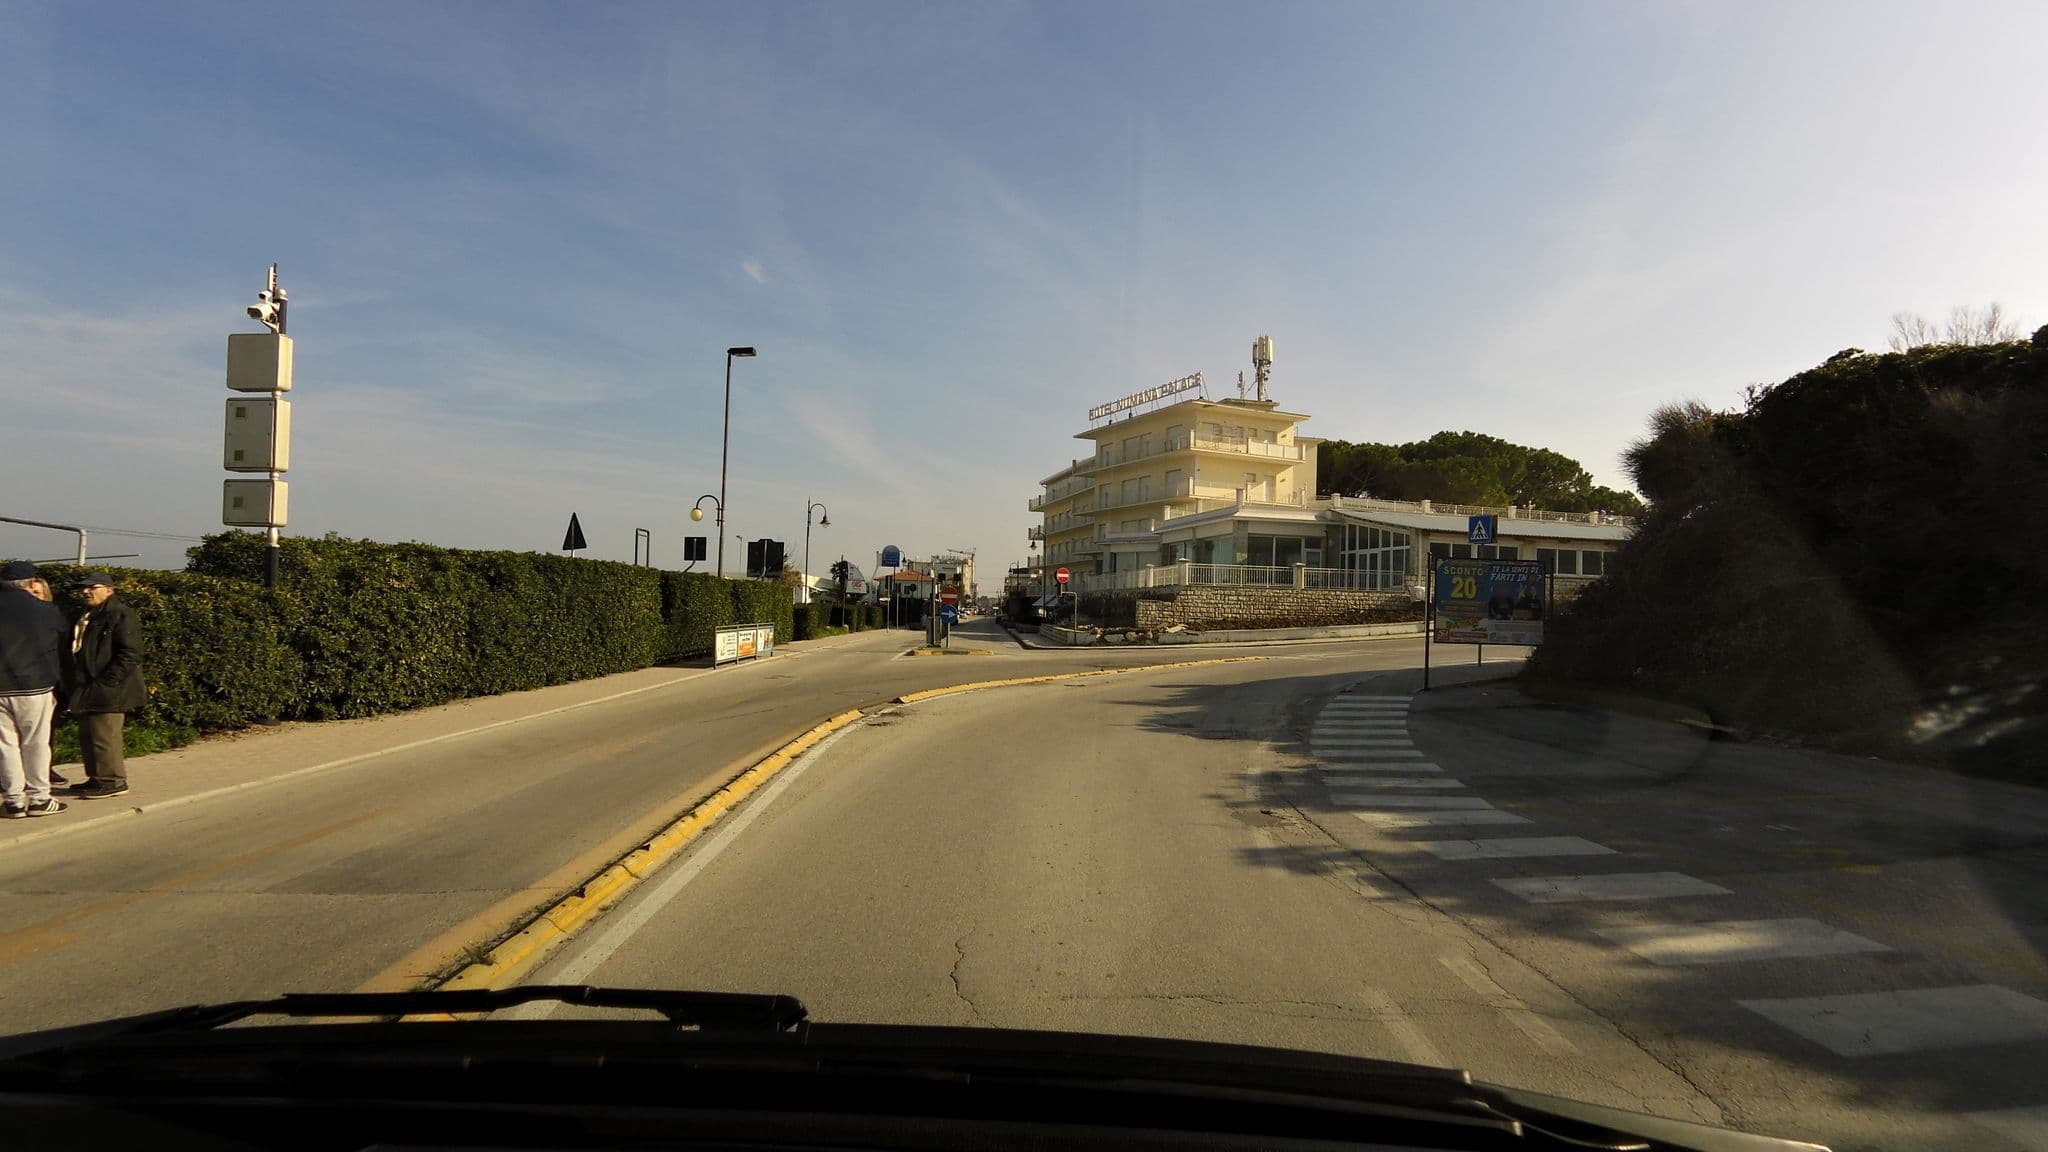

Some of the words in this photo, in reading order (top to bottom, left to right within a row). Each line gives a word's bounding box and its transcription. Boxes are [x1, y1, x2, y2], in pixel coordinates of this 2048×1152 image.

[1089, 403, 1115, 421] HOTEL
[1116, 387, 1159, 411] NUMANA
[1161, 373, 1202, 397] PALACE
[1443, 566, 1484, 576] SCONTO
[1450, 576, 1477, 599] 20
